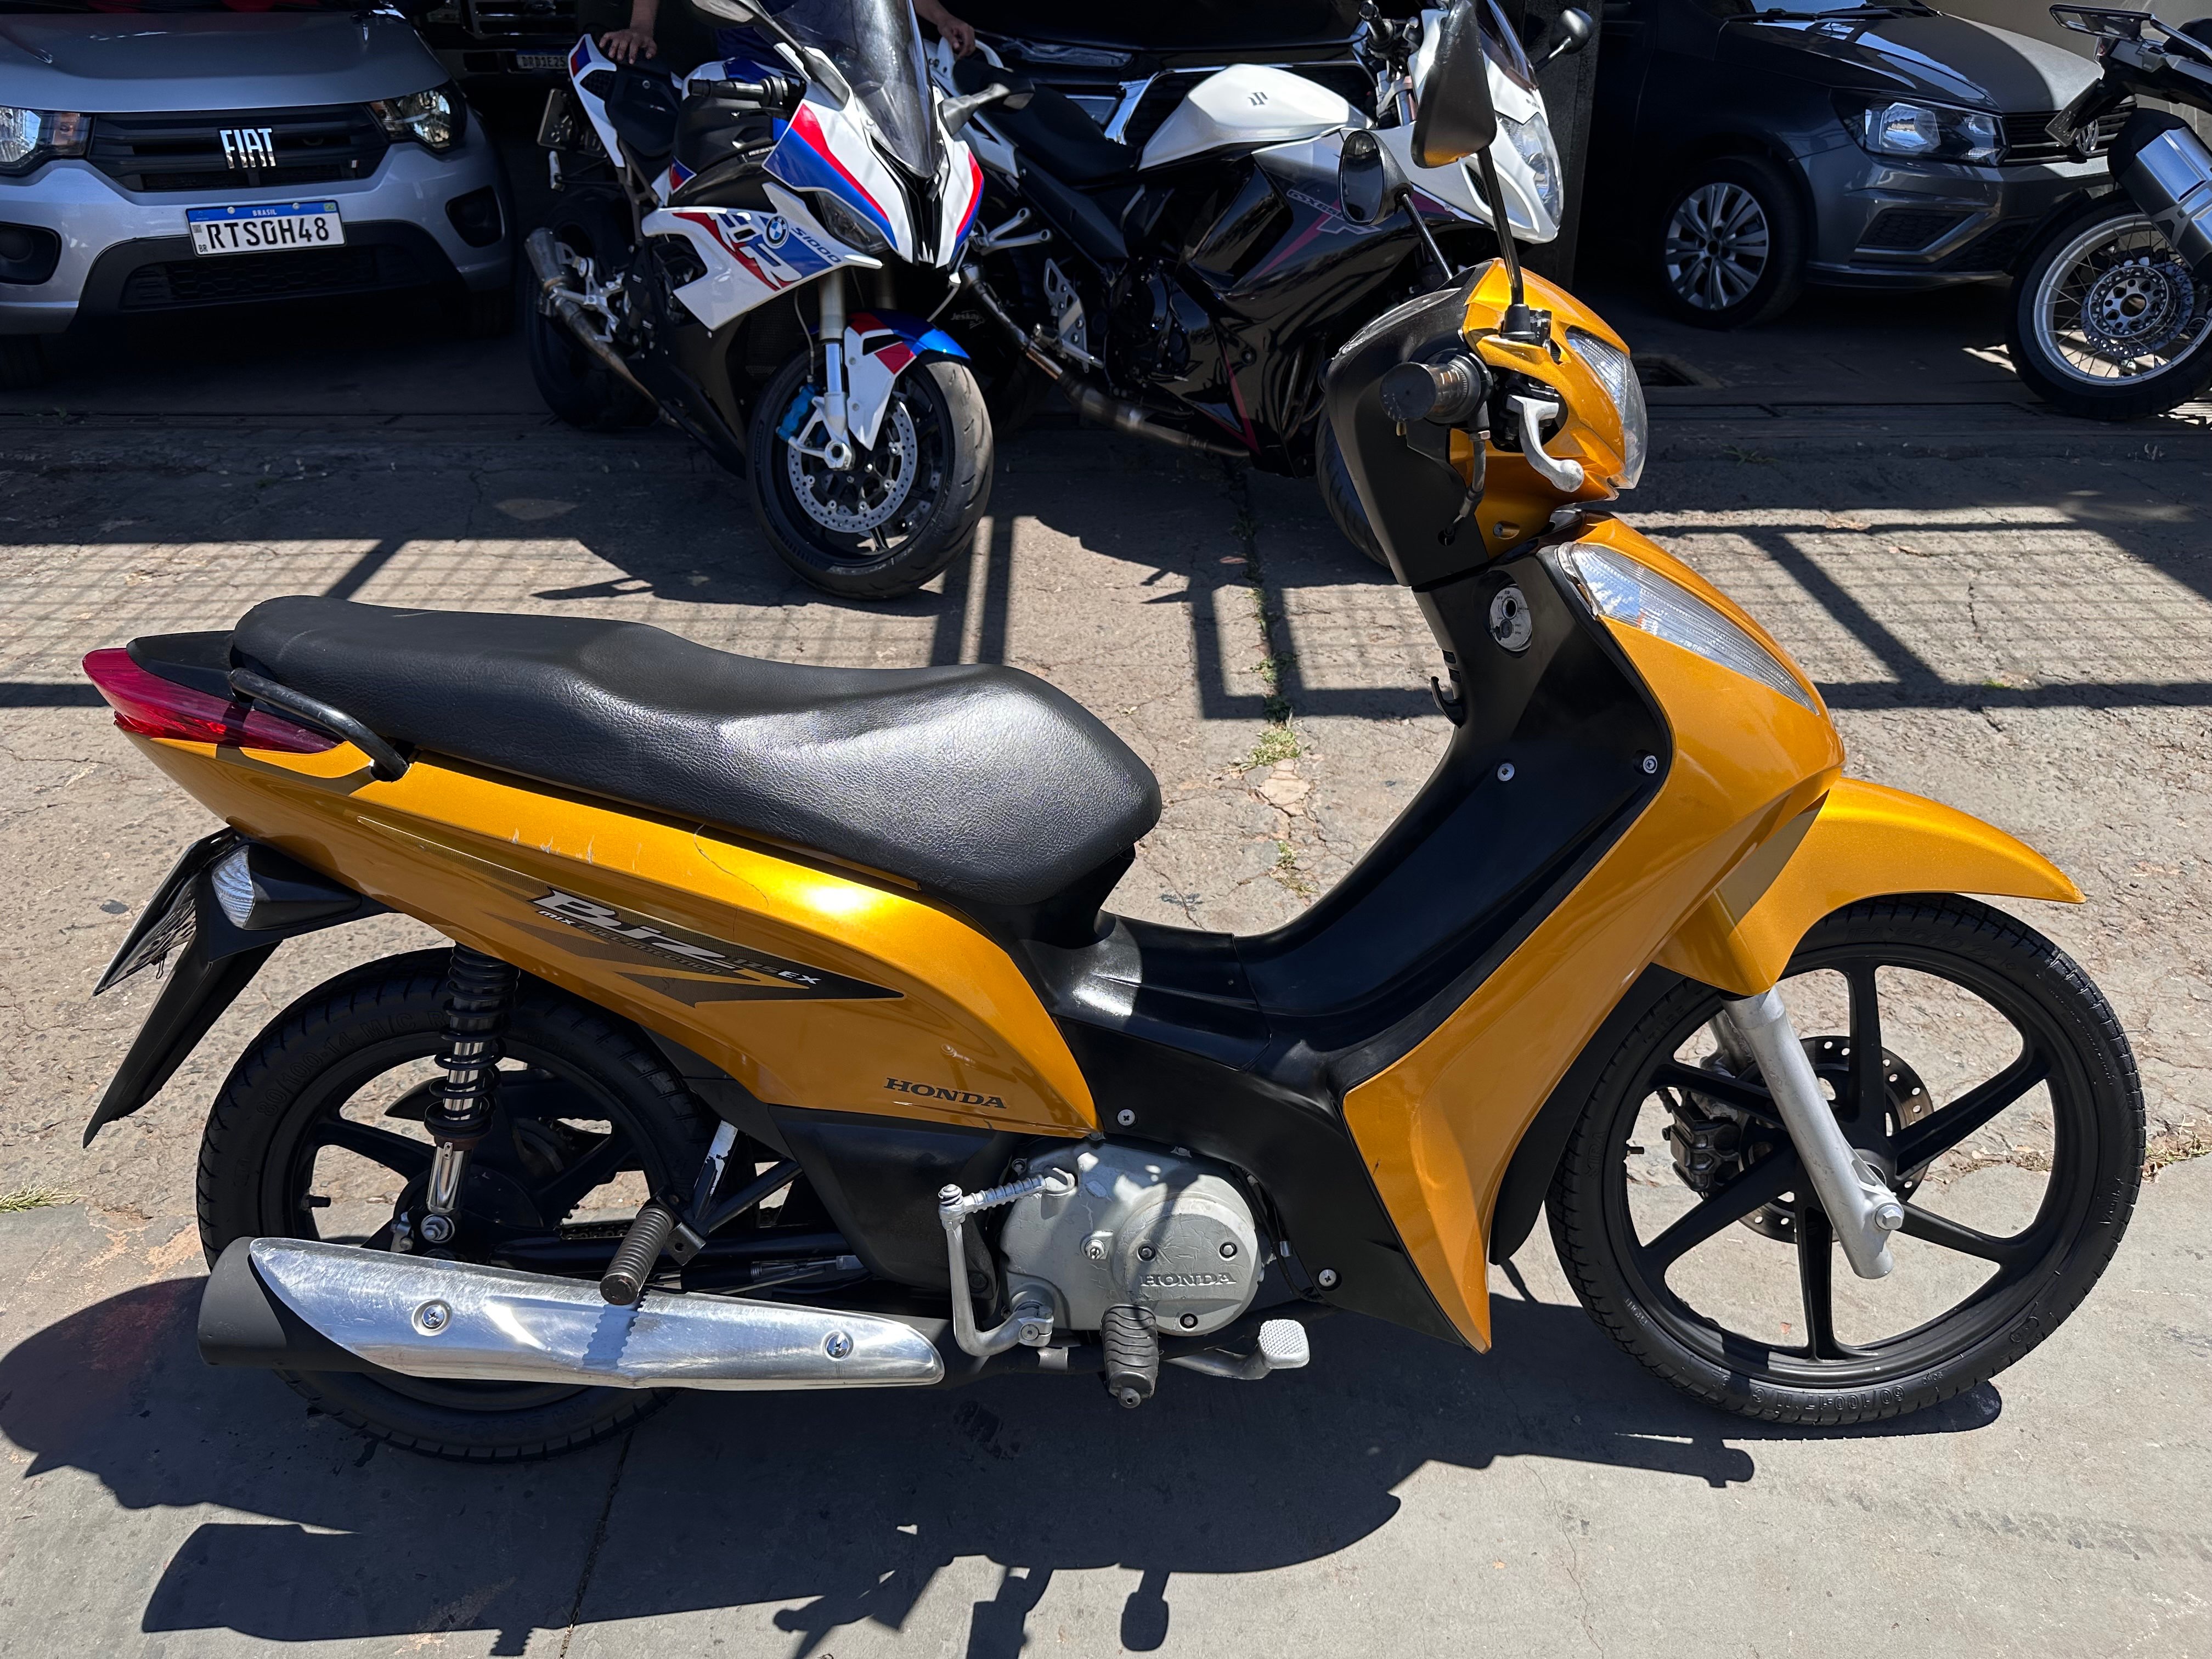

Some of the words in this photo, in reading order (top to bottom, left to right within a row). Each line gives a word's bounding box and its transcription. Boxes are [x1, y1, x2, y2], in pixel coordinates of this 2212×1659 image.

[219, 127, 276, 169] FIAT
[252, 208, 277, 217] BRASIL
[198, 244, 208, 252] BR
[791, 227, 842, 263] S1000
[778, 970, 822, 985] EX
[883, 1076, 1007, 1109] HONDA
[1139, 1272, 1237, 1287] HONDA
